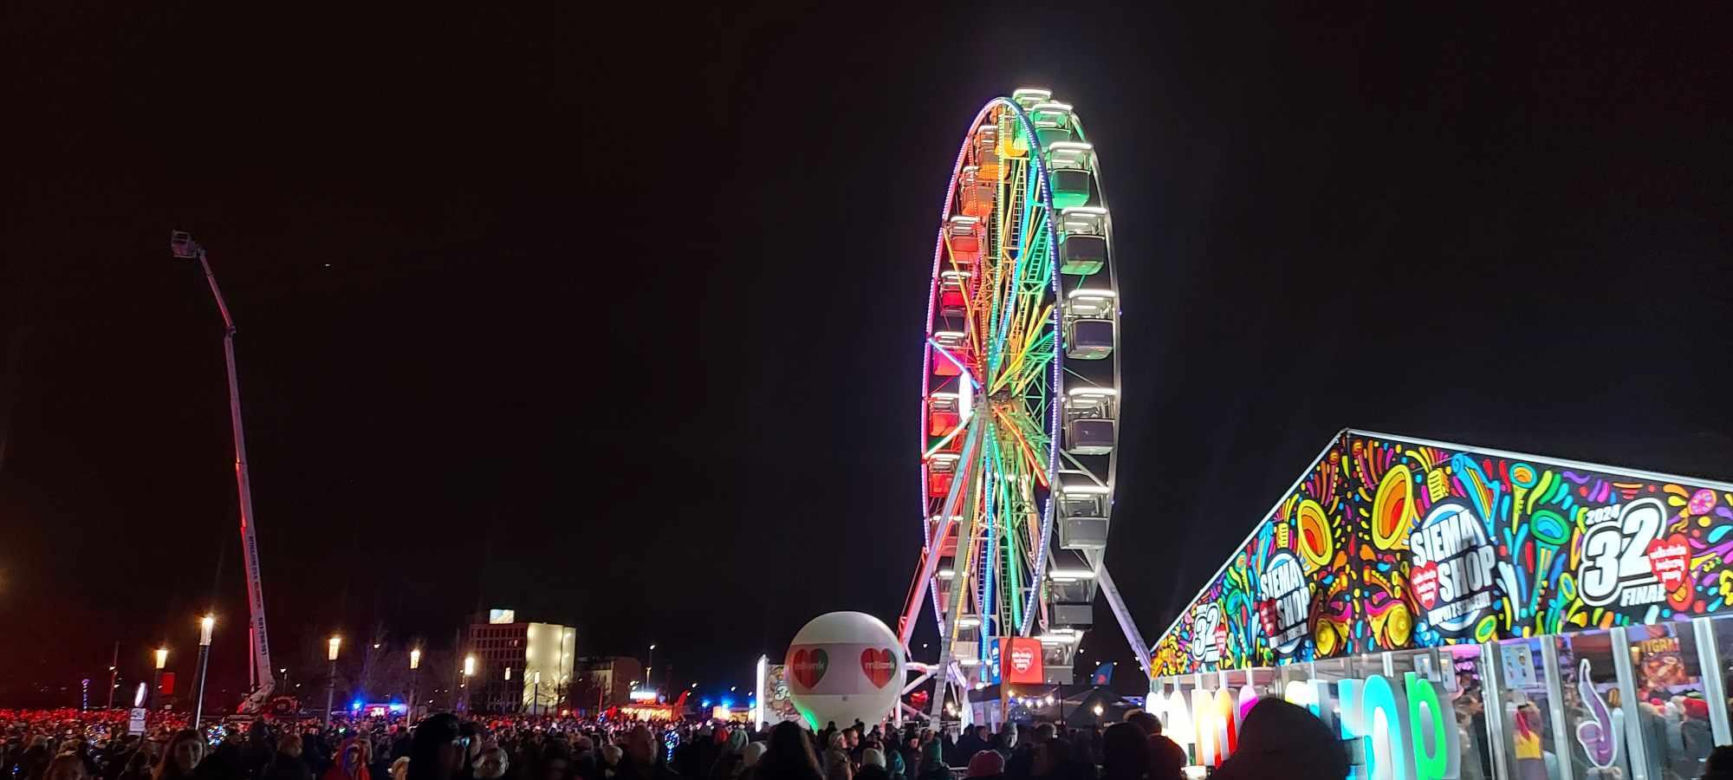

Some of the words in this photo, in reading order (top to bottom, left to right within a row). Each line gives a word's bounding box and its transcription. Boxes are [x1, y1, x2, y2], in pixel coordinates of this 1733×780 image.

[1410, 509, 1476, 567] SIEMA
[1585, 504, 1620, 524] 2024
[1438, 545, 1496, 602] SHOP
[1582, 505, 1661, 599] 32
[1260, 558, 1303, 601] SIEMA
[1193, 605, 1218, 658] 32
[1276, 586, 1310, 631] SHOP
